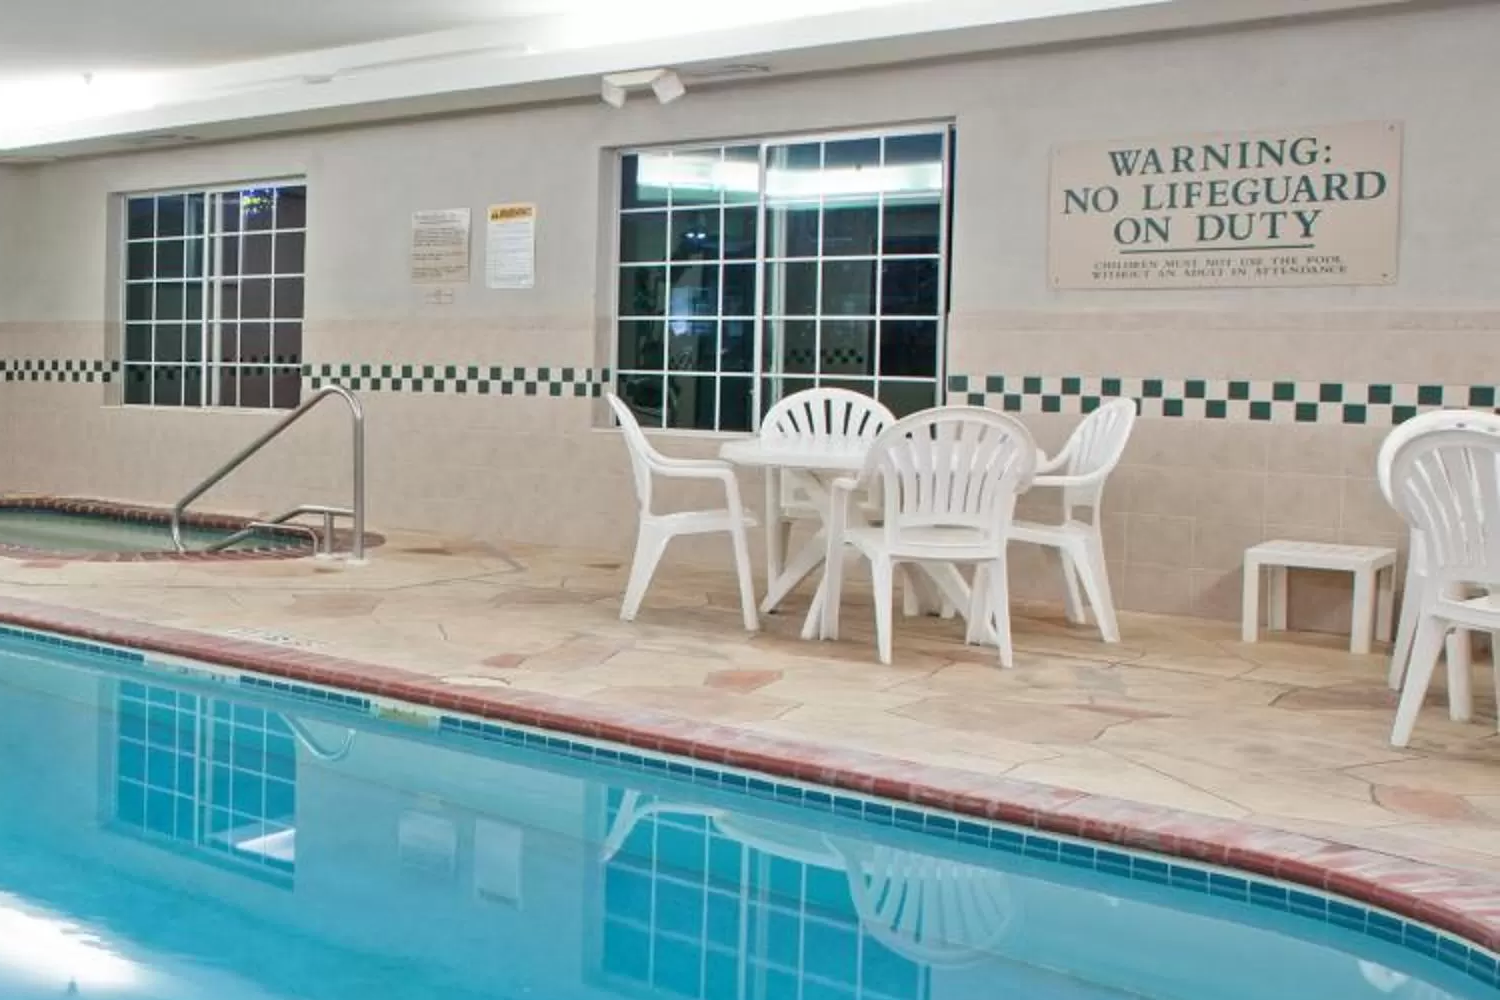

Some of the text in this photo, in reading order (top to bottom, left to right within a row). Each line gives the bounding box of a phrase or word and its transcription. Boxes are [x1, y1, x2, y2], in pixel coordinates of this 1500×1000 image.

[1108, 137, 1333, 177] WARNING:
[1062, 170, 1387, 214] NO LIFEGUARD
[1113, 209, 1323, 245] ON DUTY
[1271, 255, 1298, 265] THE
